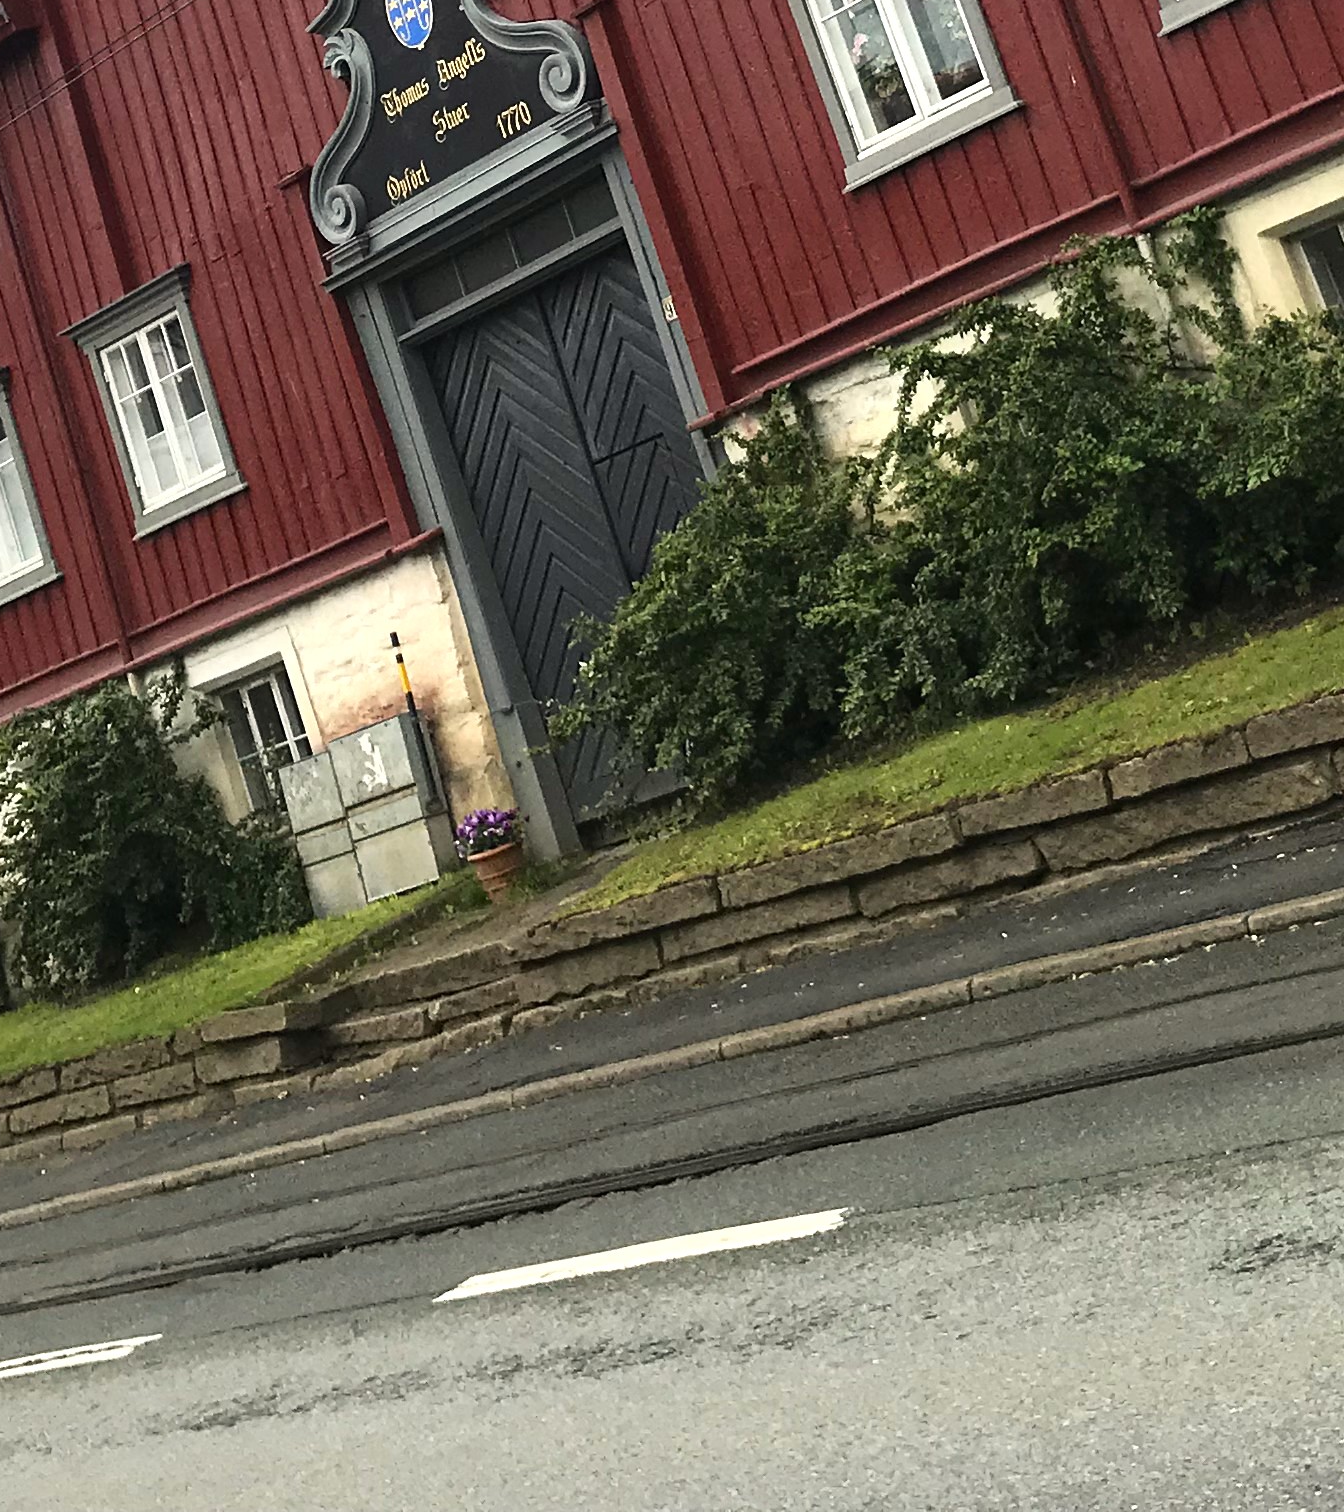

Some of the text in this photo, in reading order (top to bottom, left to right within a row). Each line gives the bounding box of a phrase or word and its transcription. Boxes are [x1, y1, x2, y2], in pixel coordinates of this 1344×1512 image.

[380, 37, 486, 124] Thomas Angells
[496, 101, 532, 139] 1770
